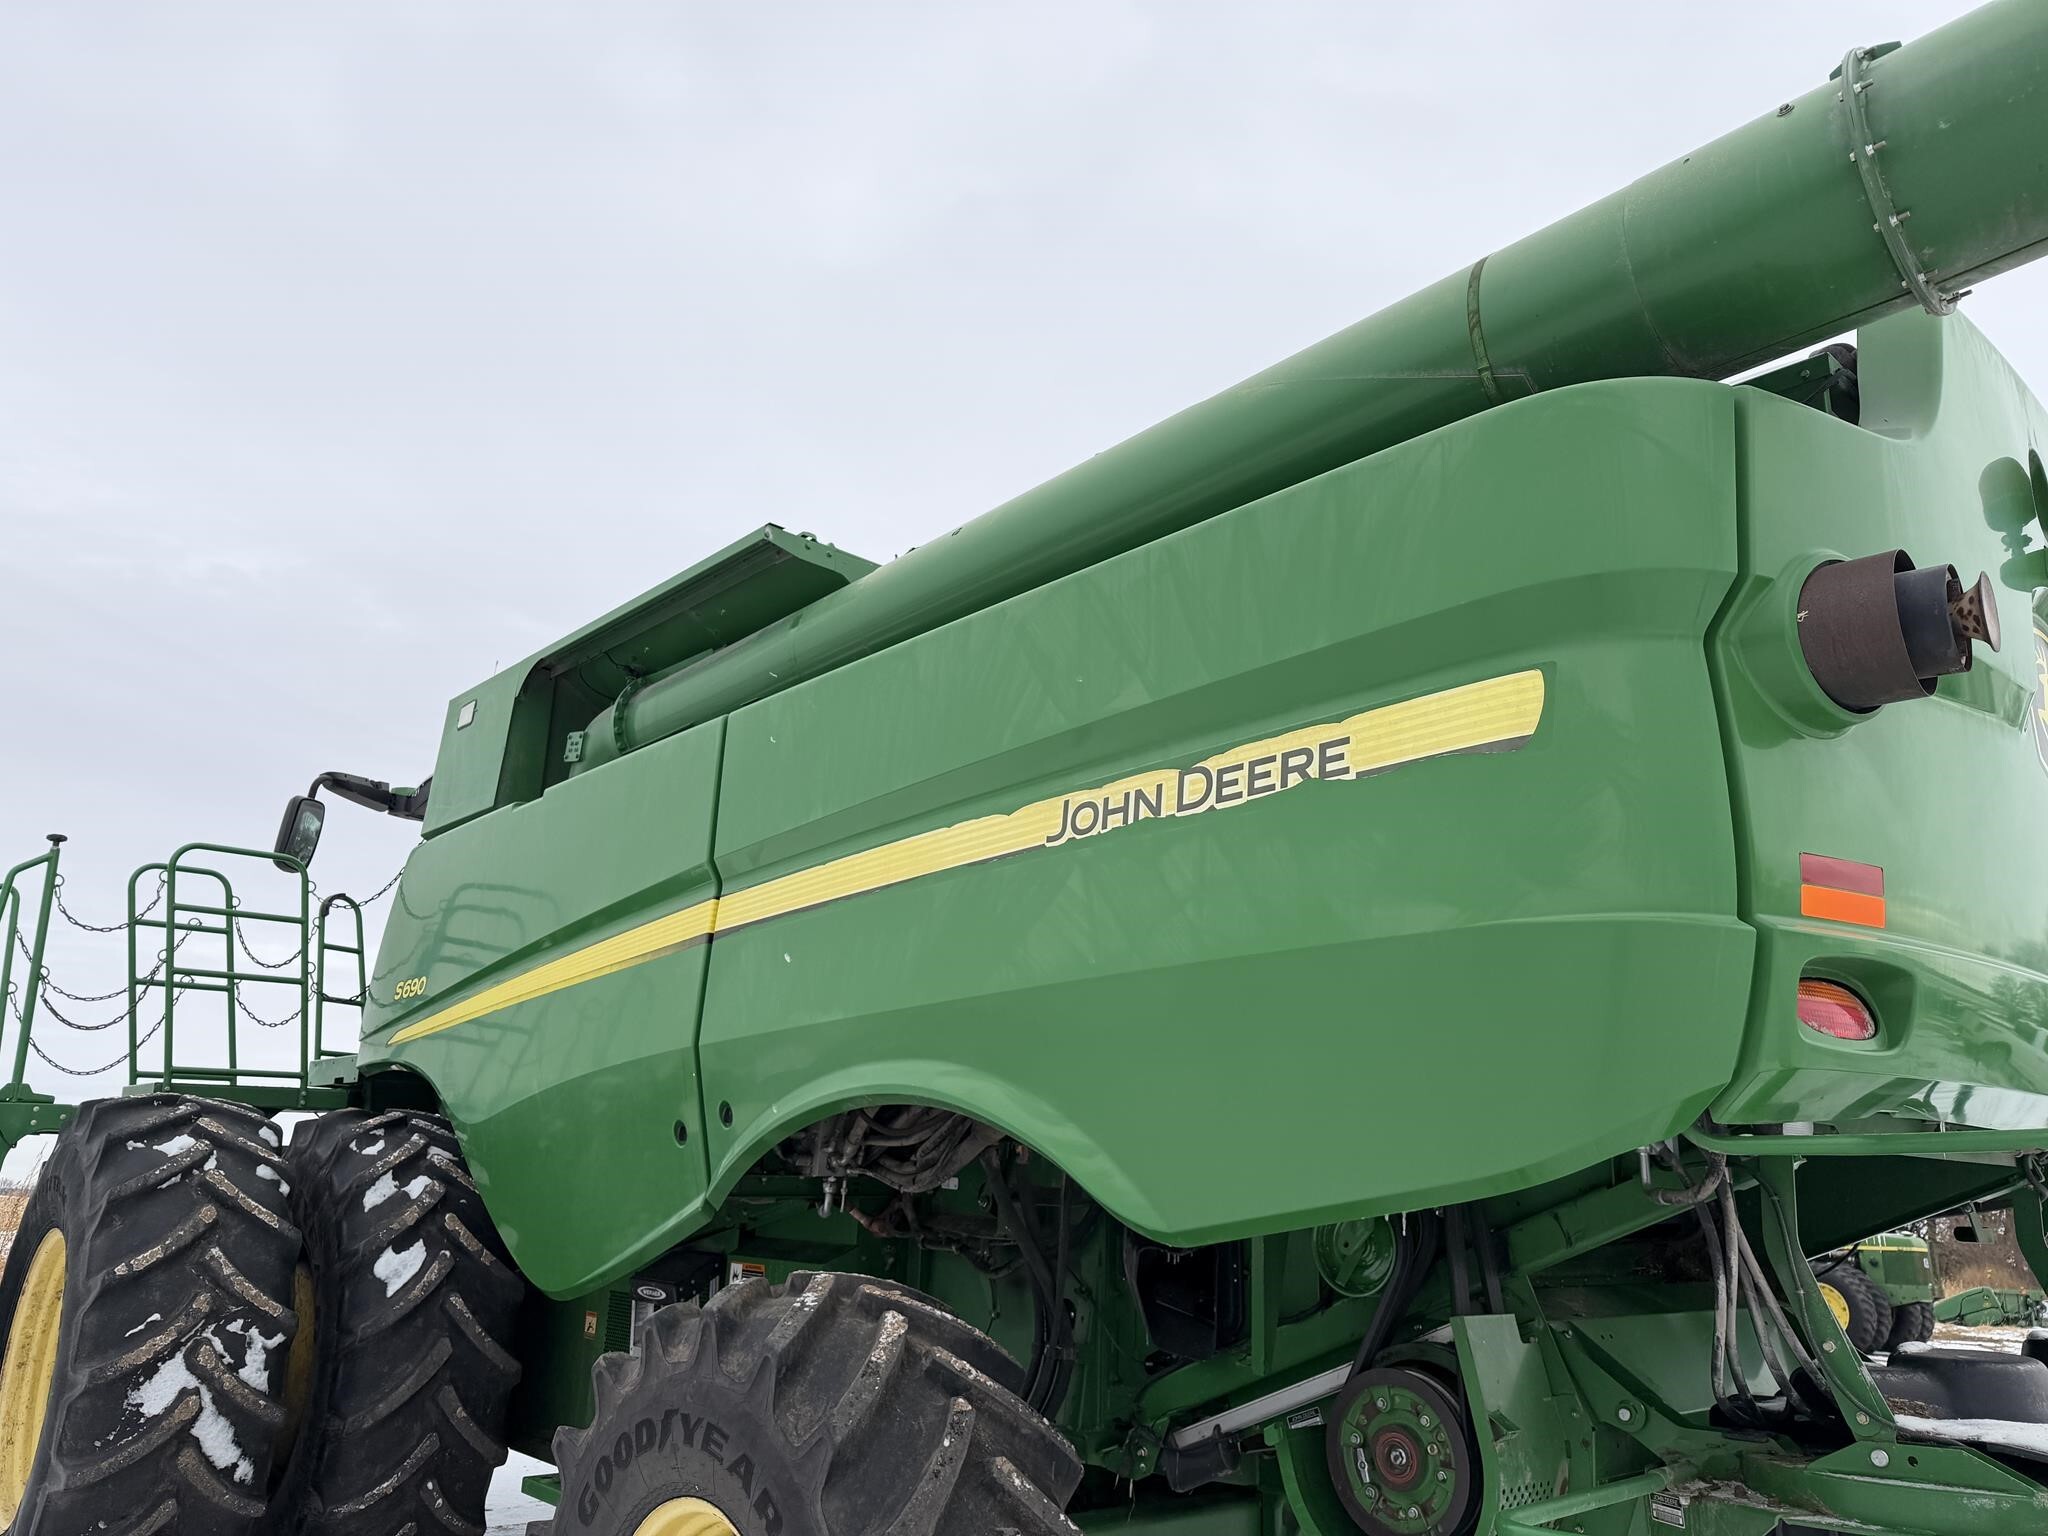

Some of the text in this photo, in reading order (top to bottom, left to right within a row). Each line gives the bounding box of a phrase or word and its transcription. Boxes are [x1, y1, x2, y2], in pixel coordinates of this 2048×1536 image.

[1045, 736, 1351, 844] JOHN DEERE
[394, 976, 427, 1000] S690
